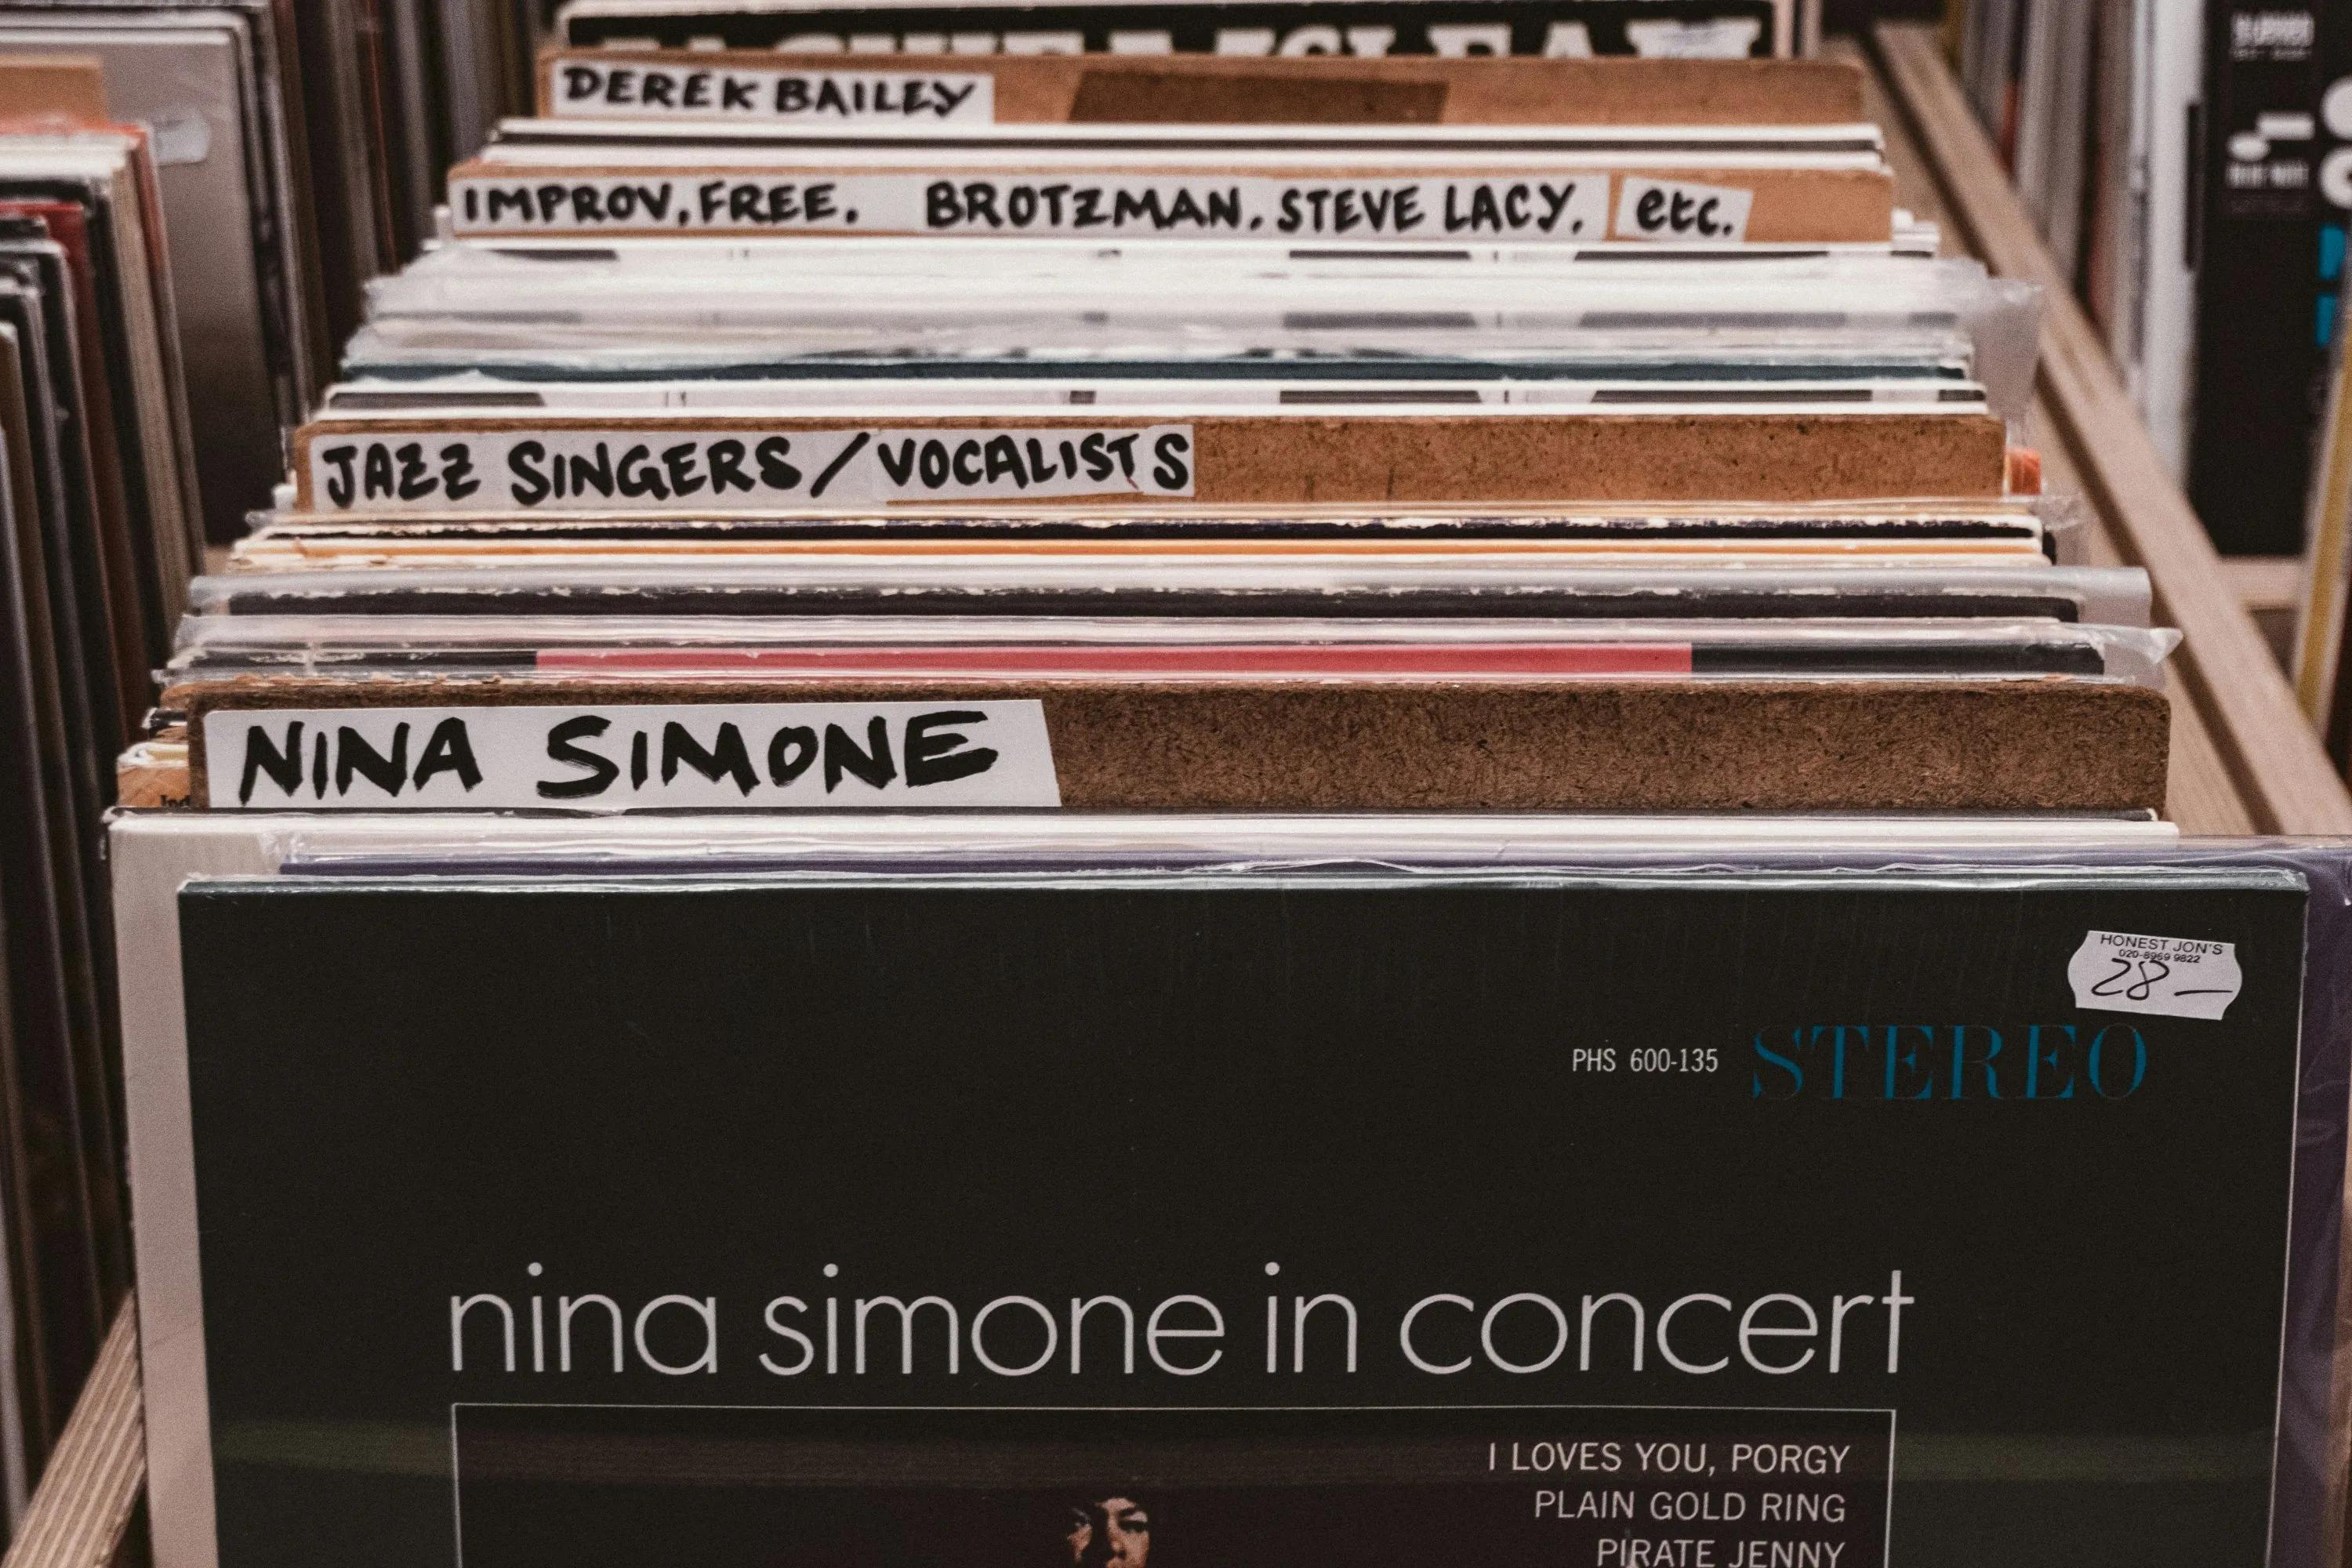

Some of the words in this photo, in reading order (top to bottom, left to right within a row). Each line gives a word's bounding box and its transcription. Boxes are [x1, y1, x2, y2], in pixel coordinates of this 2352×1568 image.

[563, 67, 757, 110] DEREK
[775, 77, 975, 118] BAILEY
[1276, 186, 1425, 234] STEVE
[1636, 189, 1733, 237] etc.
[321, 442, 481, 510] JAZZ
[238, 717, 483, 806] NINA
[536, 710, 1000, 799] SIMONE
[2100, 934, 2169, 951] HONEST
[2172, 941, 2223, 956] JON'S
[2173, 953, 2201, 964] 9822
[1572, 1047, 1617, 1073] PHS
[1630, 1047, 1719, 1073] 600-135
[1752, 1024, 2147, 1099] STEREO
[450, 1262, 717, 1376] nina
[758, 1263, 1225, 1377] simone
[1265, 1261, 1358, 1374] in
[1399, 1269, 1915, 1375] concert
[1489, 1443, 1496, 1471] I
[1512, 1442, 1622, 1472] LOVES
[1635, 1442, 1715, 1477] YOU,
[1731, 1443, 1851, 1475] PORGY
[1534, 1490, 1635, 1519] PLAIN
[1650, 1491, 1746, 1521] GOLD
[1761, 1492, 1846, 1523] RING
[1596, 1538, 1715, 1568] PIRATE
[1728, 1541, 1846, 1568] JENNY
